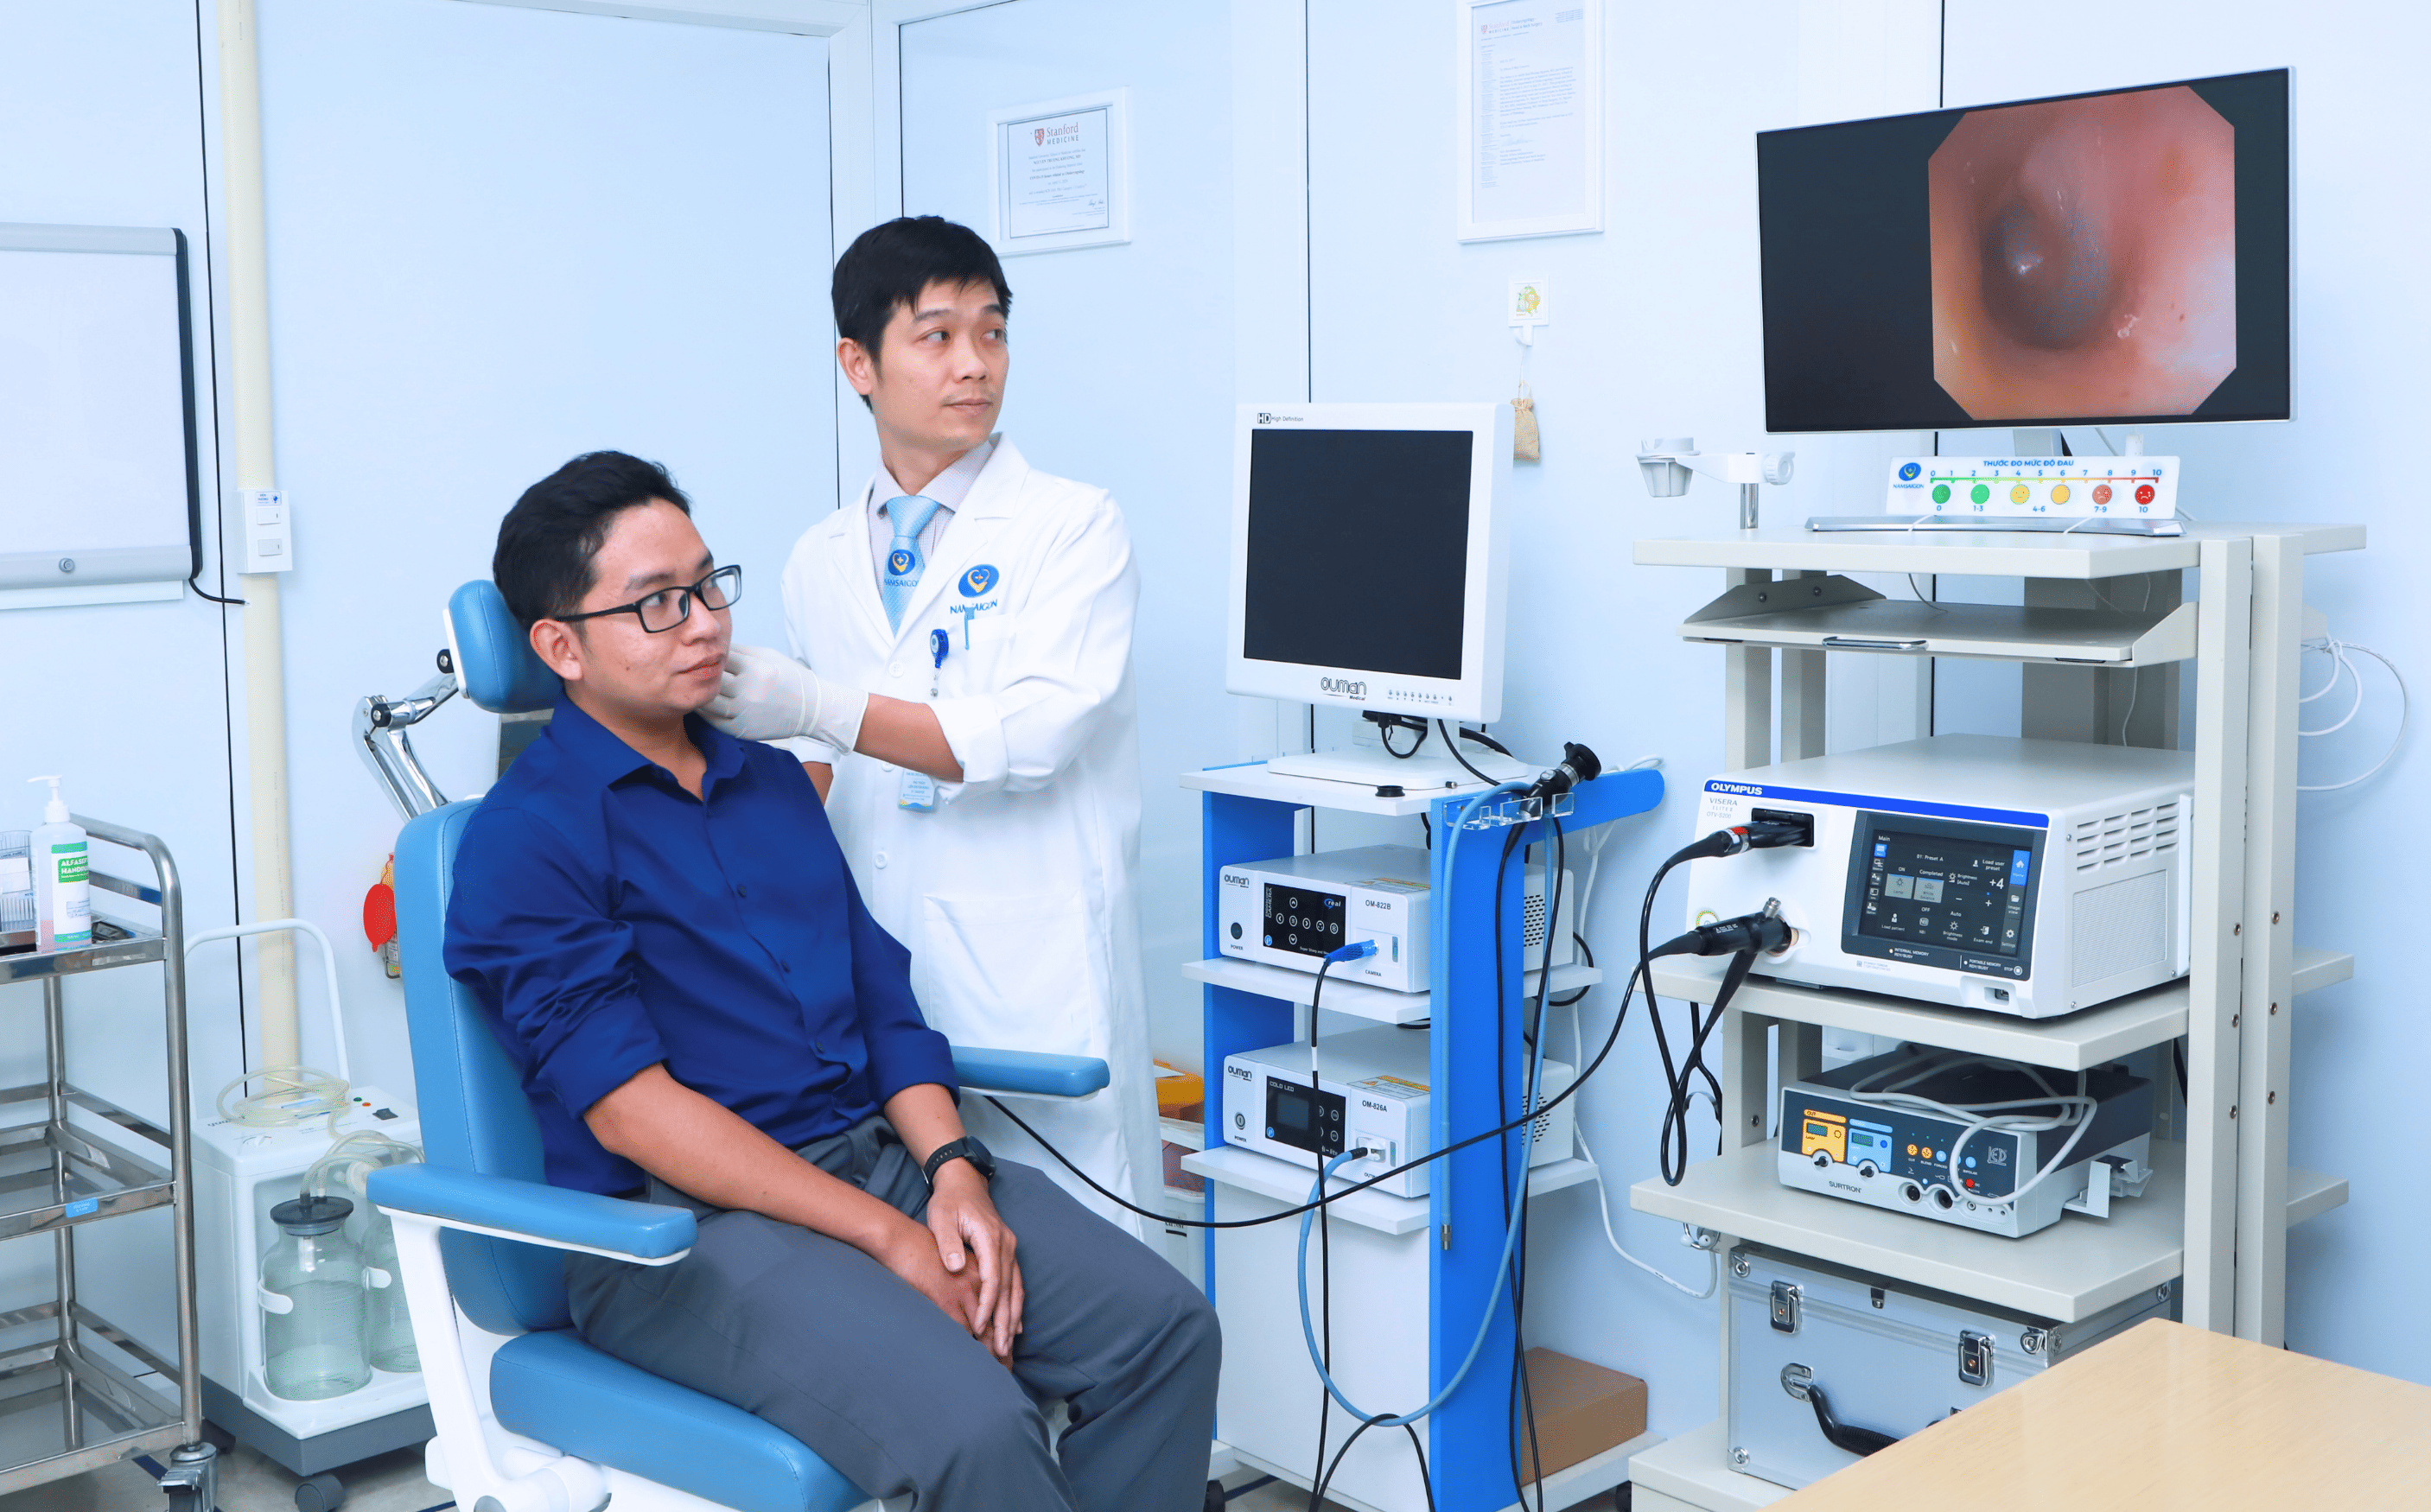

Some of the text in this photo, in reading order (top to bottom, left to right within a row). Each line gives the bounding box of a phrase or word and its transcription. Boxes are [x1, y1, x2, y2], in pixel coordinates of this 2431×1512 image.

[1047, 122, 1079, 137] Stanford
[1047, 134, 1079, 145] MEDICINE
[1257, 413, 1271, 423] HD
[950, 599, 998, 614] NAMAIGON
[1711, 783, 1763, 795] OLYMPUS
[1709, 797, 1738, 806] VISERA
[1989, 878, 2004, 889] +4
[1365, 899, 1391, 910] OM-822B
[1362, 1100, 1387, 1112] OM-826A
[1829, 1181, 1861, 1193] SURTRON
